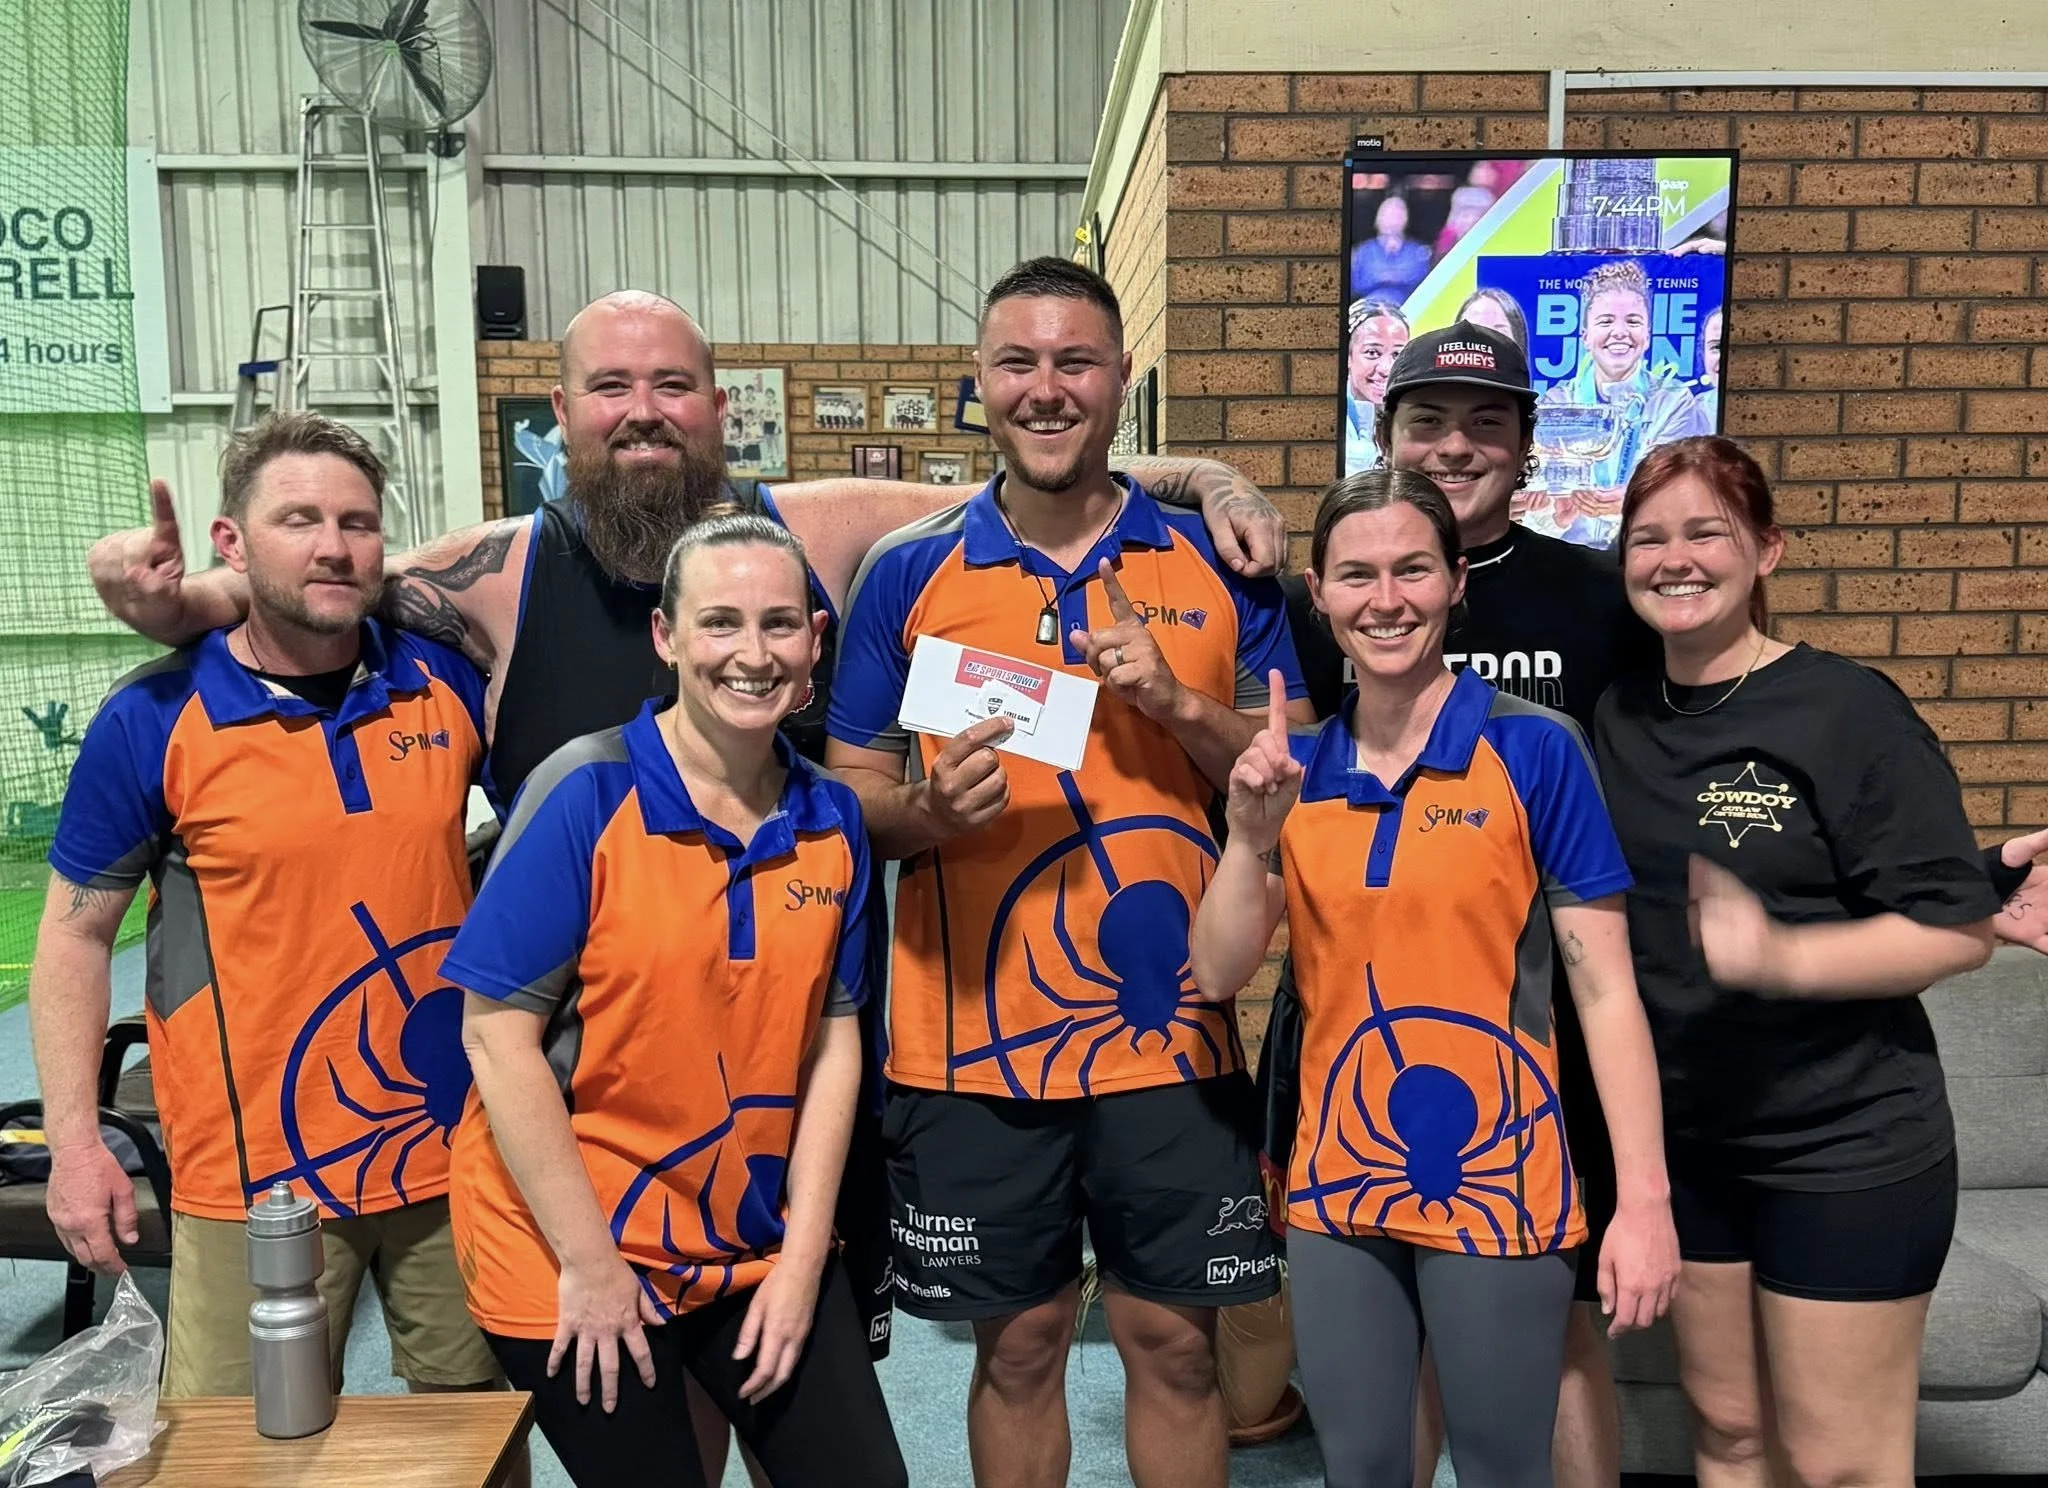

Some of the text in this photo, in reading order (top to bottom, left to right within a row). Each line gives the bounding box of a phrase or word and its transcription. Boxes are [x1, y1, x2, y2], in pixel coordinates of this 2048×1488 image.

[1357, 138, 1382, 147] motio
[1593, 196, 1685, 217] 7:44PM
[1538, 278, 1561, 290] THE
[1656, 278, 1699, 289] TENNIS
[24, 338, 123, 364] hours
[1438, 342, 1493, 354] I FEEL LIKE A
[1438, 352, 1495, 368] TOOHEYS
[980, 665, 1040, 689] SPORTSPOWER
[388, 730, 432, 761] SPM
[1418, 804, 1463, 832] SPM
[785, 878, 832, 911] SPM
[905, 1203, 976, 1232] Turner
[890, 1218, 979, 1252] Freeman
[922, 1254, 982, 1268] LAWYERS
[1212, 1254, 1276, 1284] MyPlace
